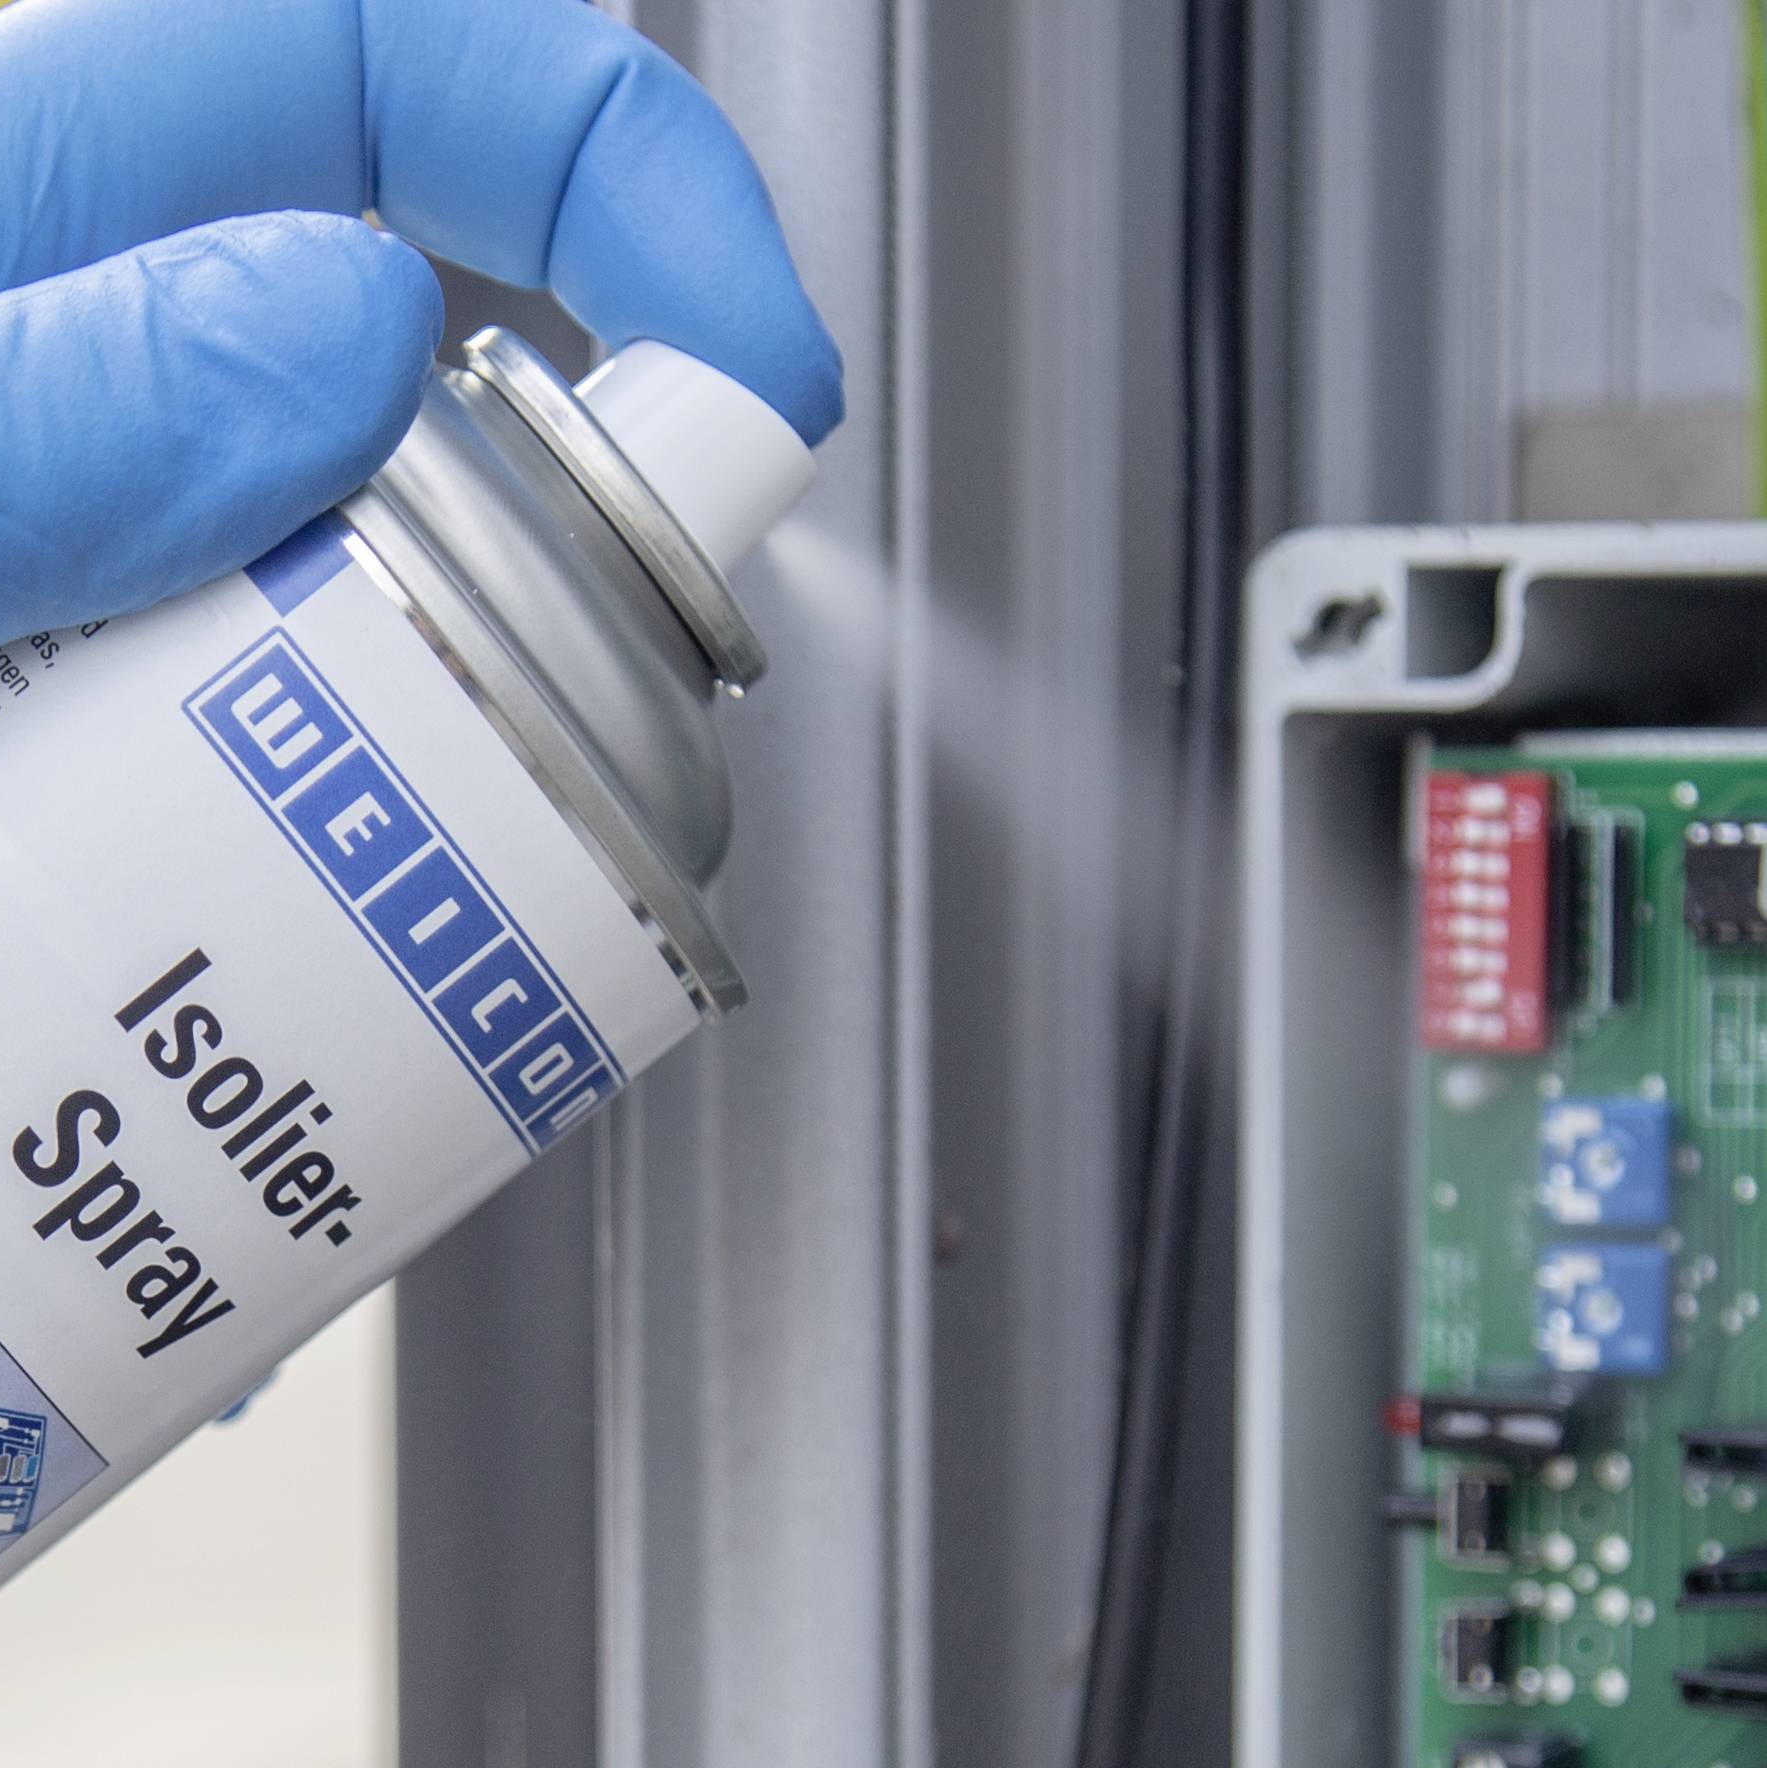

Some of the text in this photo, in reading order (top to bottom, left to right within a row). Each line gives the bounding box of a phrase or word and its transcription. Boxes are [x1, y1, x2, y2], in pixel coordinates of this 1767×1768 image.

[229, 671, 594, 1123] WEICON
[12, 1089, 237, 1360] Spray
[113, 947, 363, 1248] Isolier-
